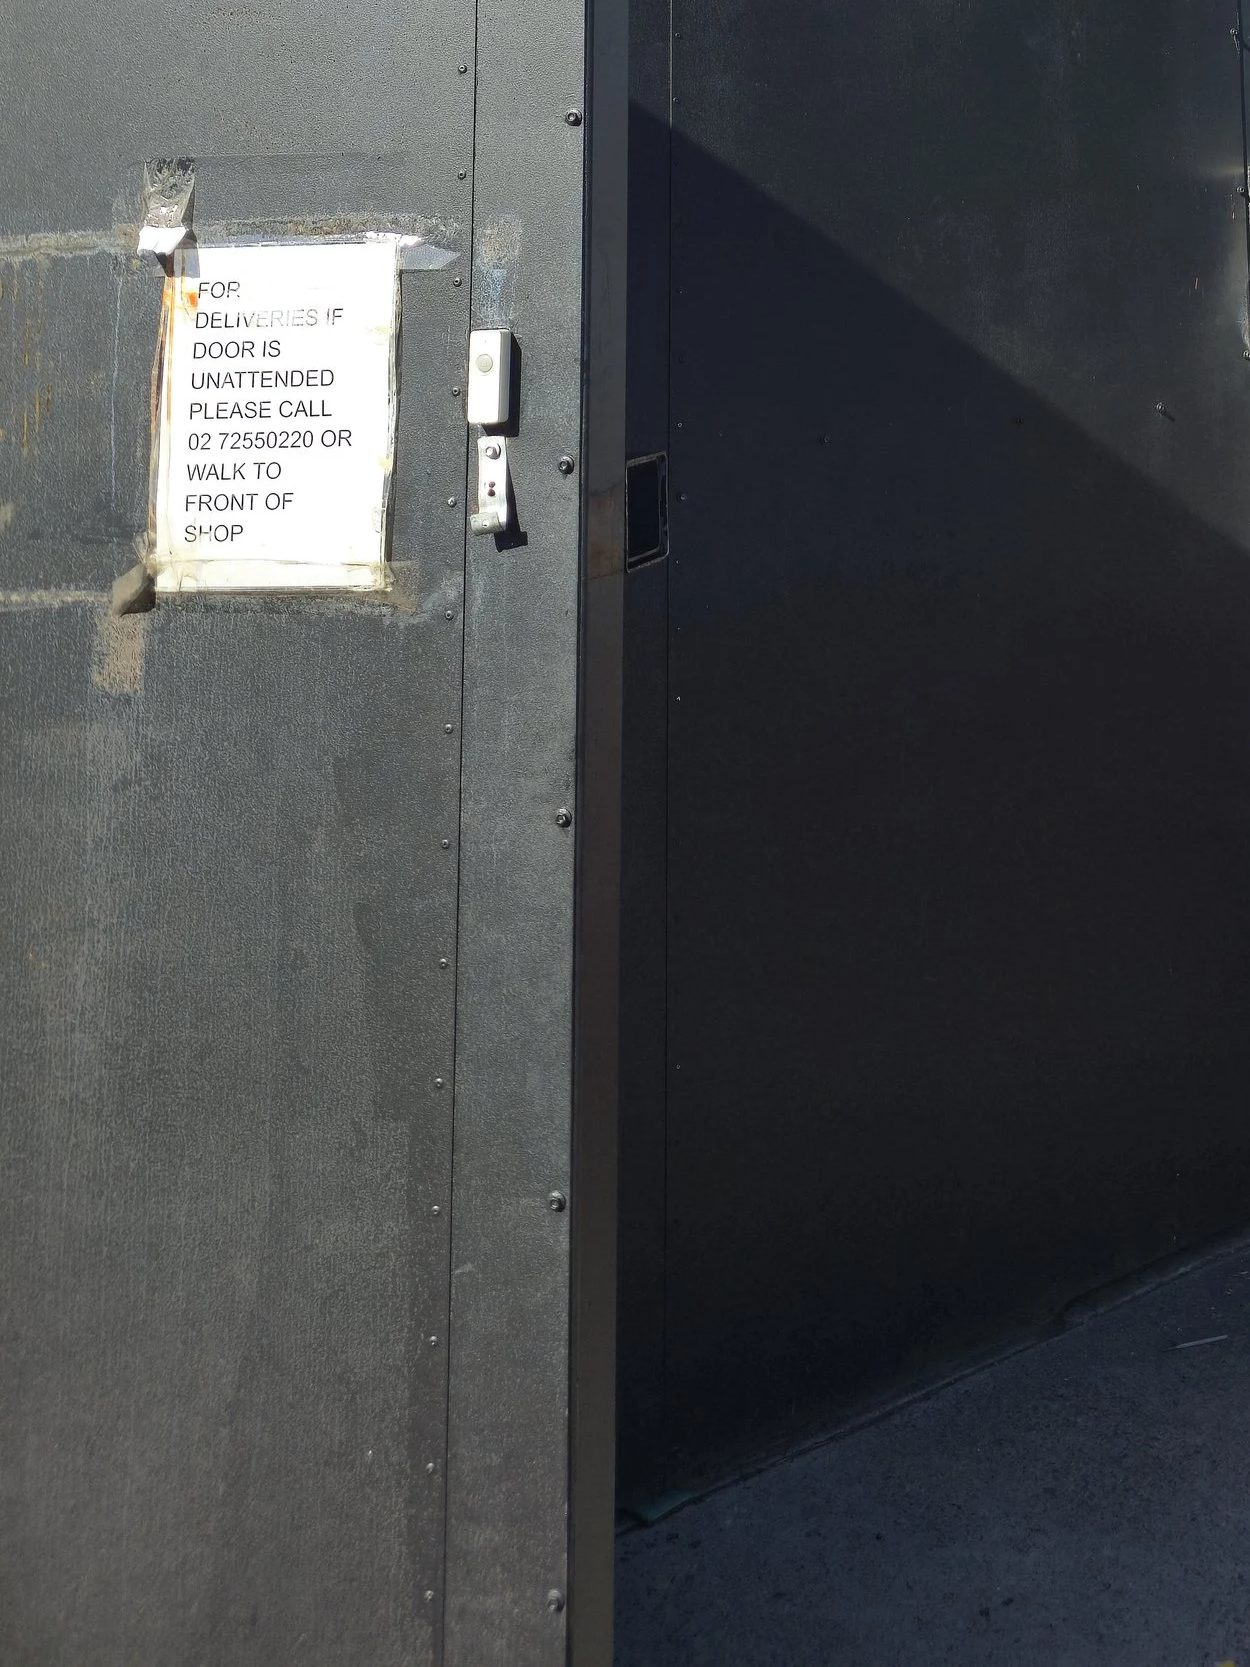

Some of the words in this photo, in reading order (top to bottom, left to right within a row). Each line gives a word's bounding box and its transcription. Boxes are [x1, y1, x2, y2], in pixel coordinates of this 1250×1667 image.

[198, 281, 241, 299] FOR
[195, 308, 318, 329] DELIVERIES
[326, 308, 344, 326] IF
[193, 341, 255, 359] DOOR
[262, 340, 281, 358] IS
[191, 369, 334, 390] UNATTENDED
[189, 401, 271, 420] PLEASE
[279, 399, 332, 418] CALL
[188, 432, 212, 451] 02
[218, 430, 314, 450] 72550220
[321, 429, 352, 447] OR
[187, 462, 246, 481] WALK
[253, 461, 282, 480] TO
[185, 493, 259, 512] FRONT
[265, 492, 294, 510] OF
[184, 524, 244, 542] SHOP
